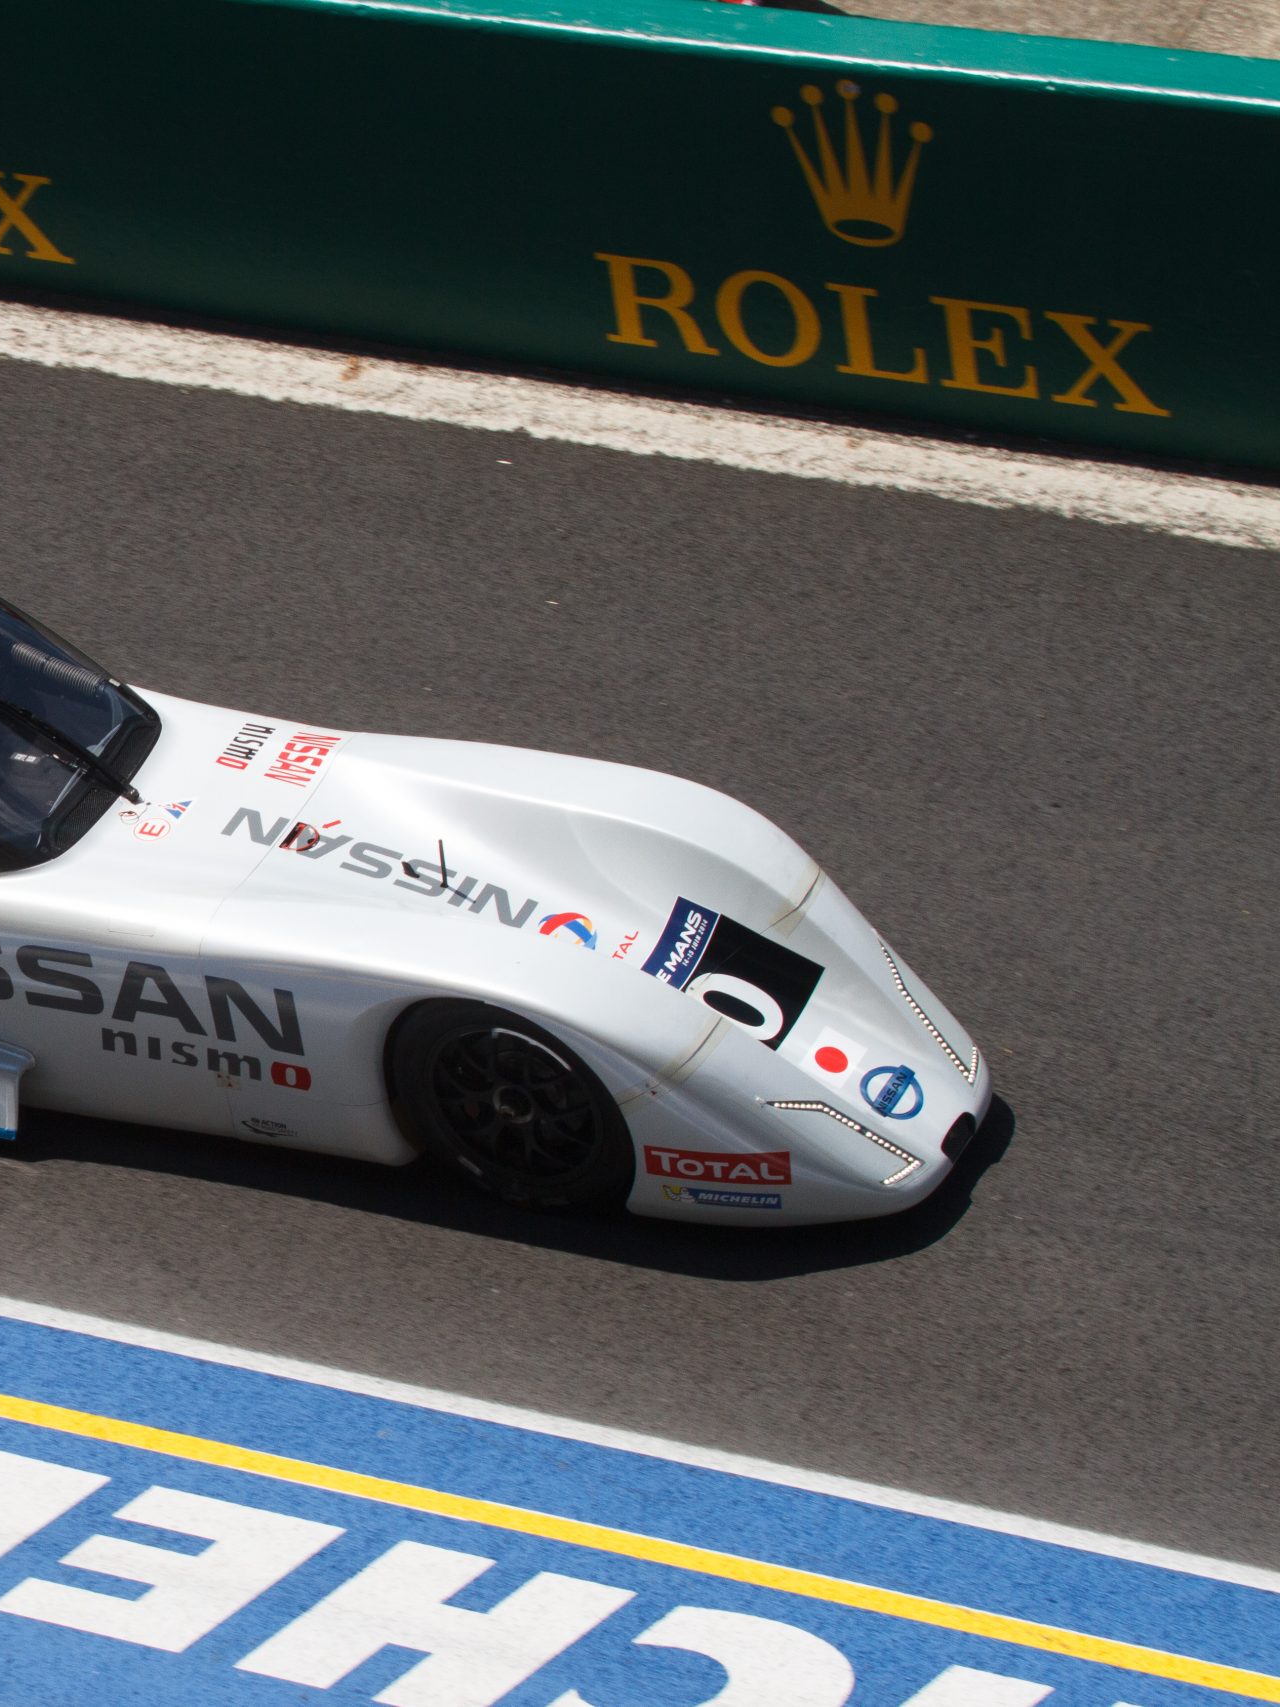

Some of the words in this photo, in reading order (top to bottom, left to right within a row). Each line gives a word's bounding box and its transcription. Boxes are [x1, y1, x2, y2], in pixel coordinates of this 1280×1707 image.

[594, 252, 1172, 418] ROLEX
[264, 732, 341, 787] NISSAN
[138, 822, 166, 837] E
[221, 806, 539, 929] NISSAN
[612, 930, 639, 960] TAL
[664, 909, 702, 973] MANS
[877, 1071, 908, 1111] NISSAN
[651, 1150, 785, 1181] TOTAL
[698, 1192, 779, 1206] MICHELIN
